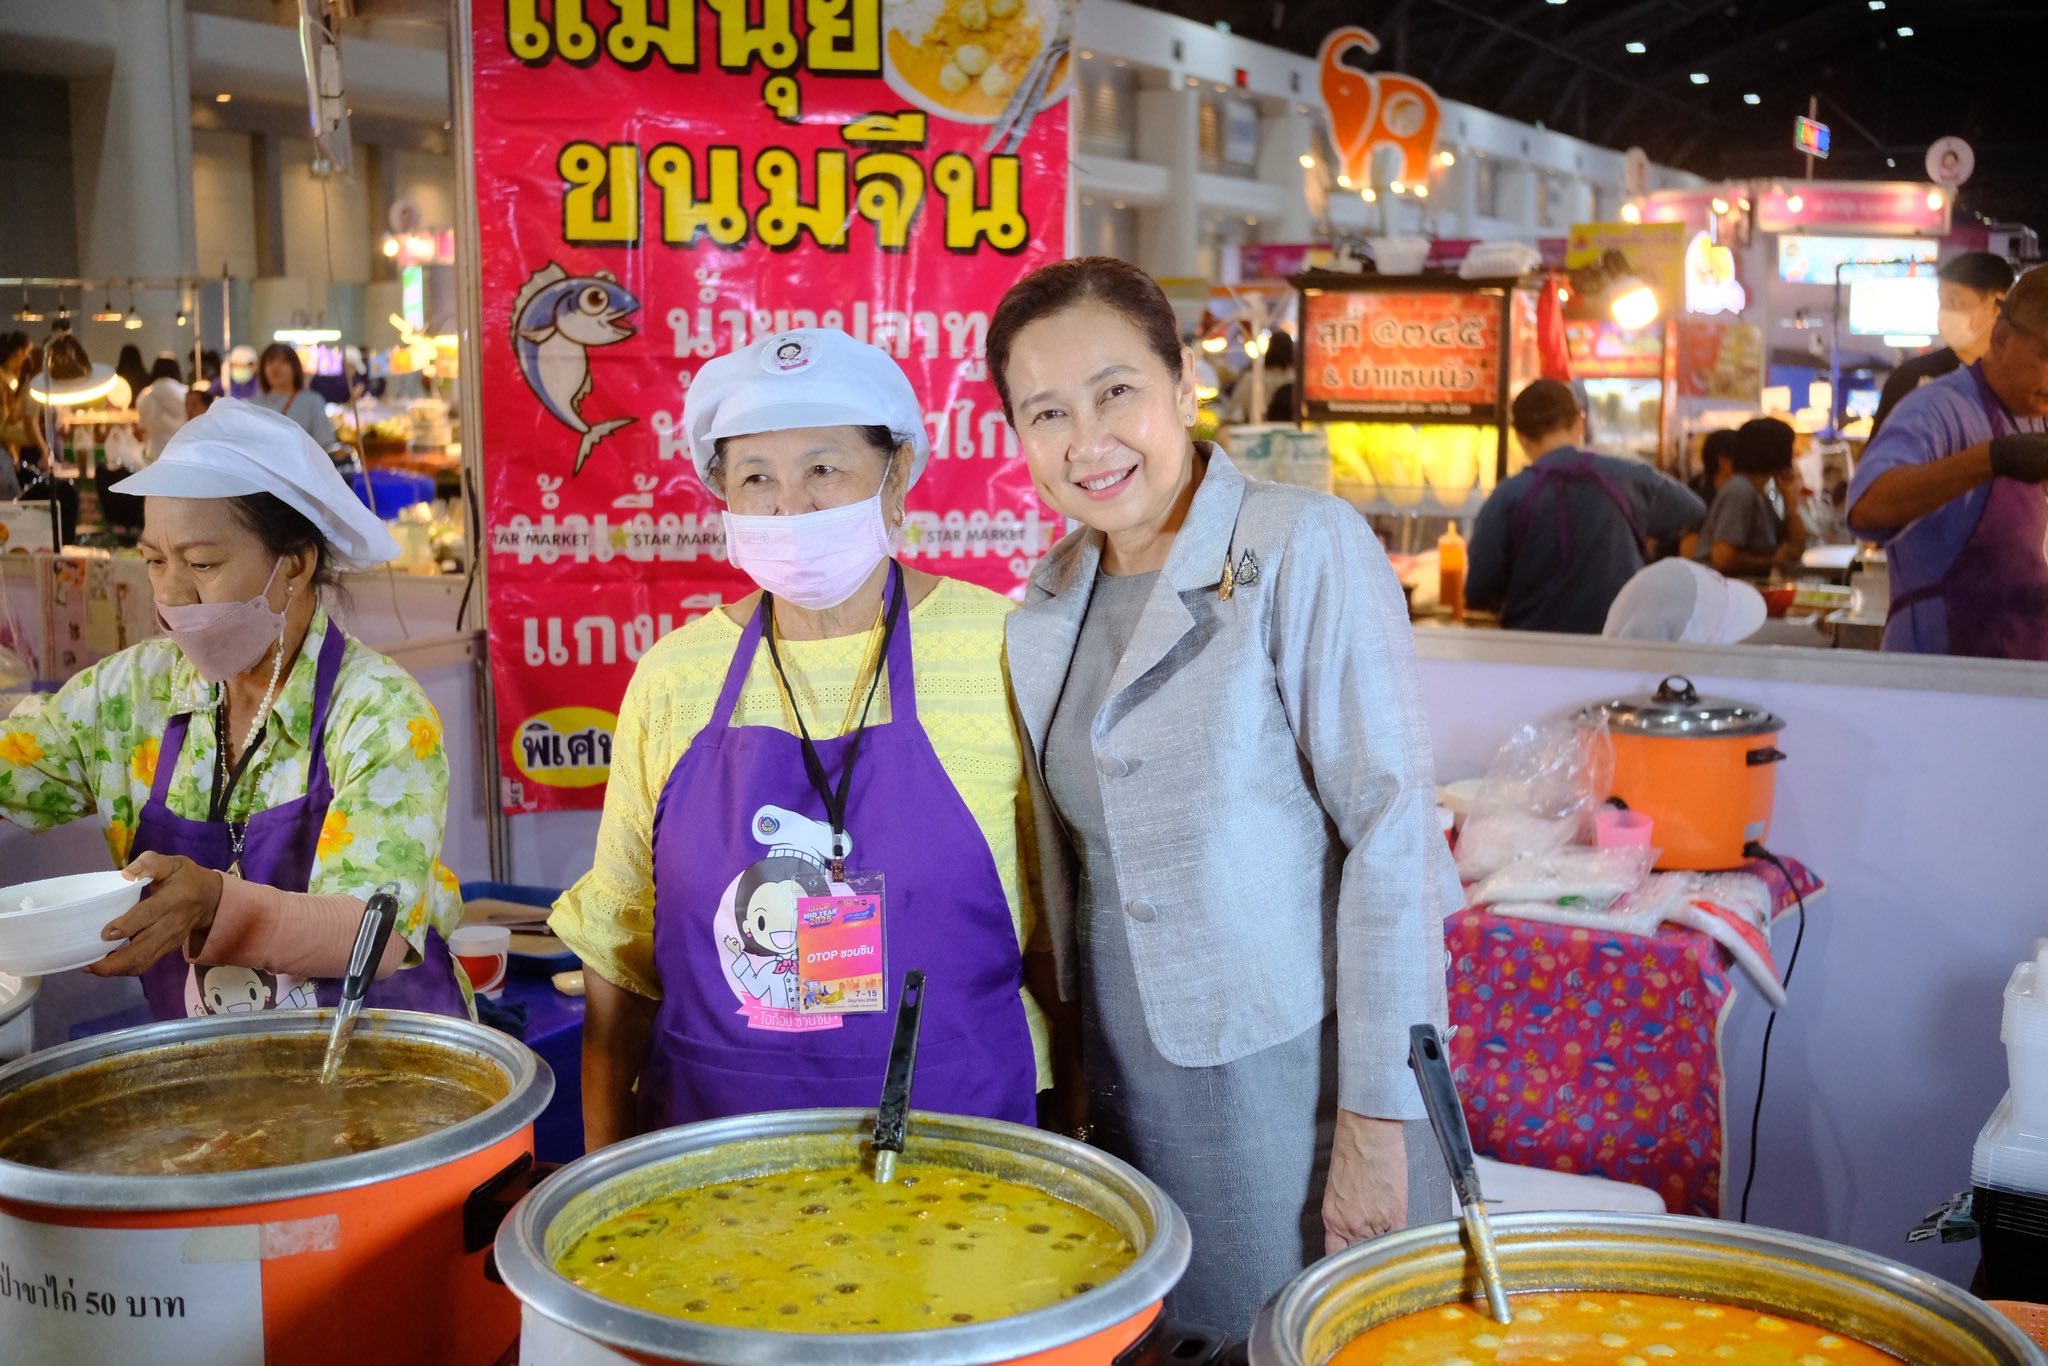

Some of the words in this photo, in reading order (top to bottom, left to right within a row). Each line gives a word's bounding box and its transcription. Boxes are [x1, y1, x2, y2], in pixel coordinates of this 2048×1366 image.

[558, 112, 1030, 258] ขนมจีน
[526, 533, 589, 547] MARKET
[633, 533, 671, 546] STAR
[927, 530, 962, 543] STAR
[966, 529, 1025, 543] MARKET
[819, 908, 838, 917] YEAR
[809, 915, 832, 926] 2025
[807, 950, 838, 963] OTOP
[840, 945, 874, 959] ชวนชิม
[85, 1291, 117, 1317] 50
[125, 1296, 186, 1318] บาท
